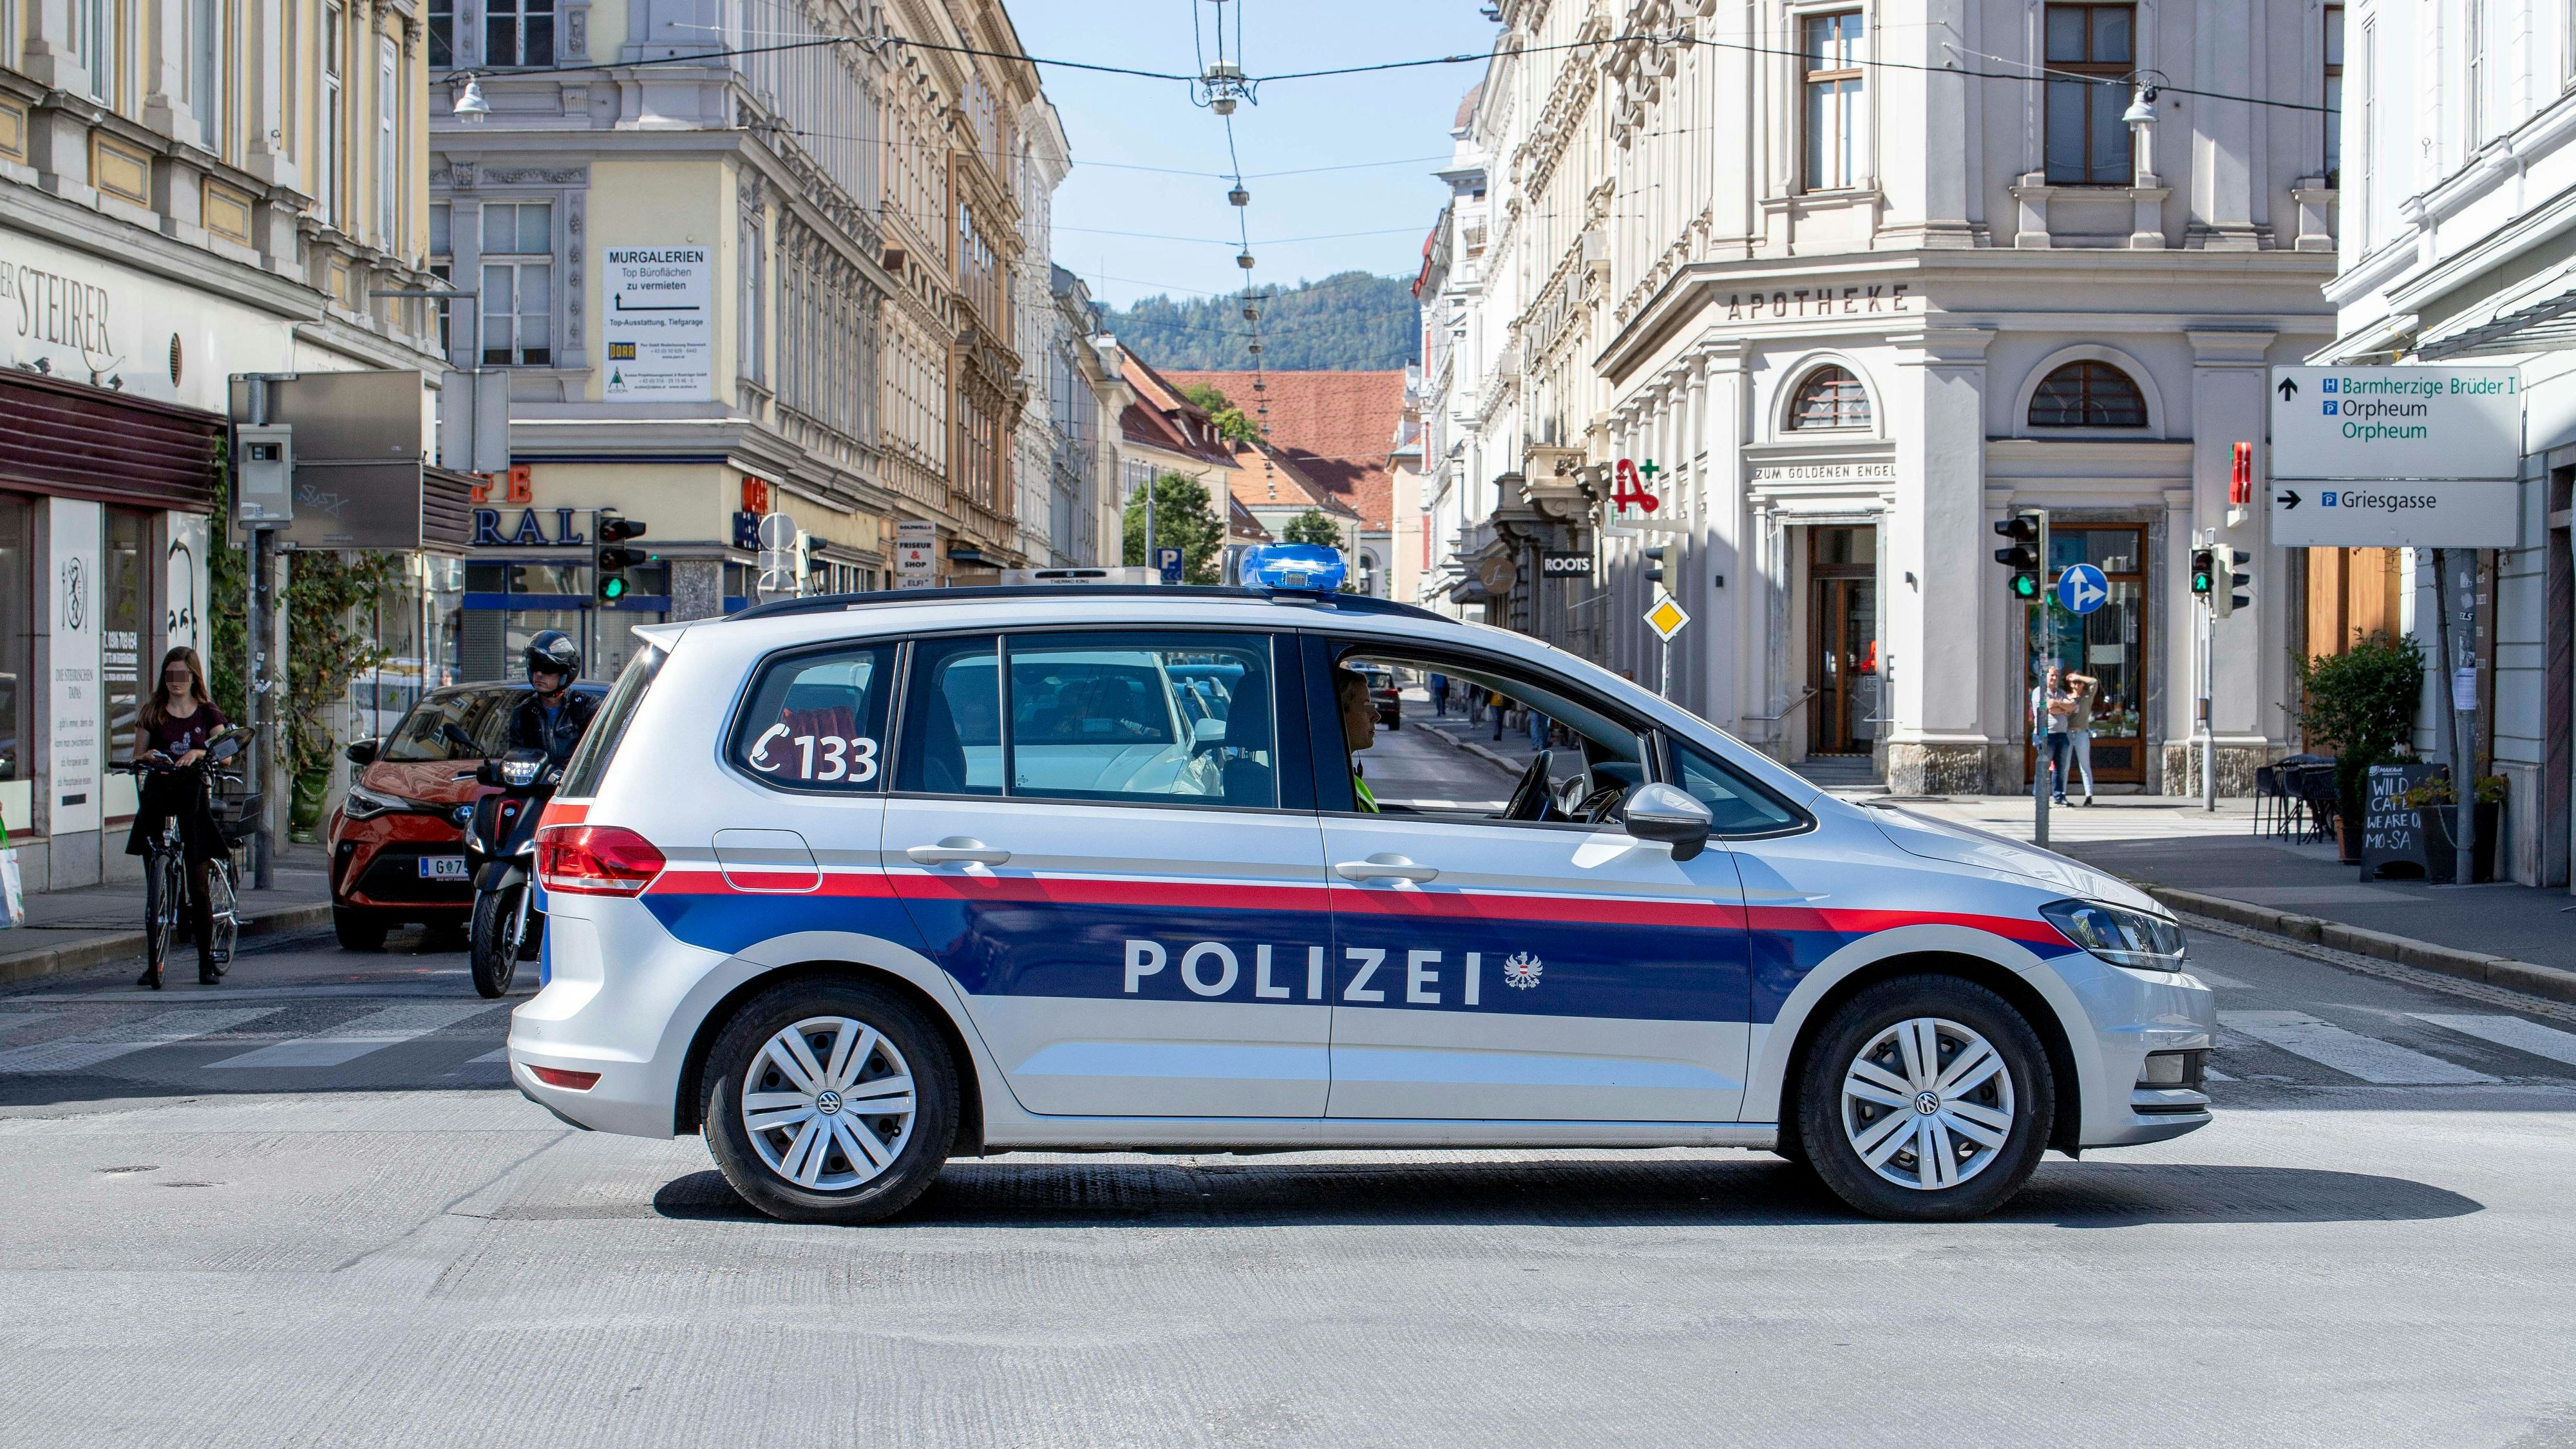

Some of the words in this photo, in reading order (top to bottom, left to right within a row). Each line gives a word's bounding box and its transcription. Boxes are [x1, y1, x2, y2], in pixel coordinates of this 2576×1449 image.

[610, 251, 703, 263] MURGALERIEN
[622, 268, 637, 278] Top
[639, 267, 692, 277] Büroflächen
[641, 280, 686, 290] vermieten
[1728, 284, 1908, 320] APOTHEKE
[17, 265, 126, 373] STEIRER
[610, 318, 666, 327] Top-Ausstattung,
[668, 318, 703, 327] Tiefgarage
[2343, 377, 2443, 399] Barmherzige
[2451, 377, 2503, 394] Brüder
[2508, 377, 2515, 394] I
[2343, 399, 2427, 421] Orpheum
[2342, 421, 2427, 442] Orpheum
[1755, 468, 1782, 480] ZUM
[1789, 466, 1850, 478] GOLDENEN
[1858, 464, 1896, 477] ENGEL
[2342, 490, 2437, 513] Griesgasse
[910, 550, 920, 560] &
[1161, 550, 1178, 569] P
[1544, 558, 1590, 571] ROOTS
[65, 668, 93, 681] STEIRISCHEN
[68, 686, 82, 699] TAPAS
[794, 735, 877, 782] 133
[2372, 777, 2409, 796] WILD
[2367, 815, 2383, 829] WE
[2384, 814, 2408, 829] ARE
[2365, 830, 2411, 850] MO-SA
[436, 860, 444, 874] G
[1124, 940, 1481, 1005] POLIZEI
